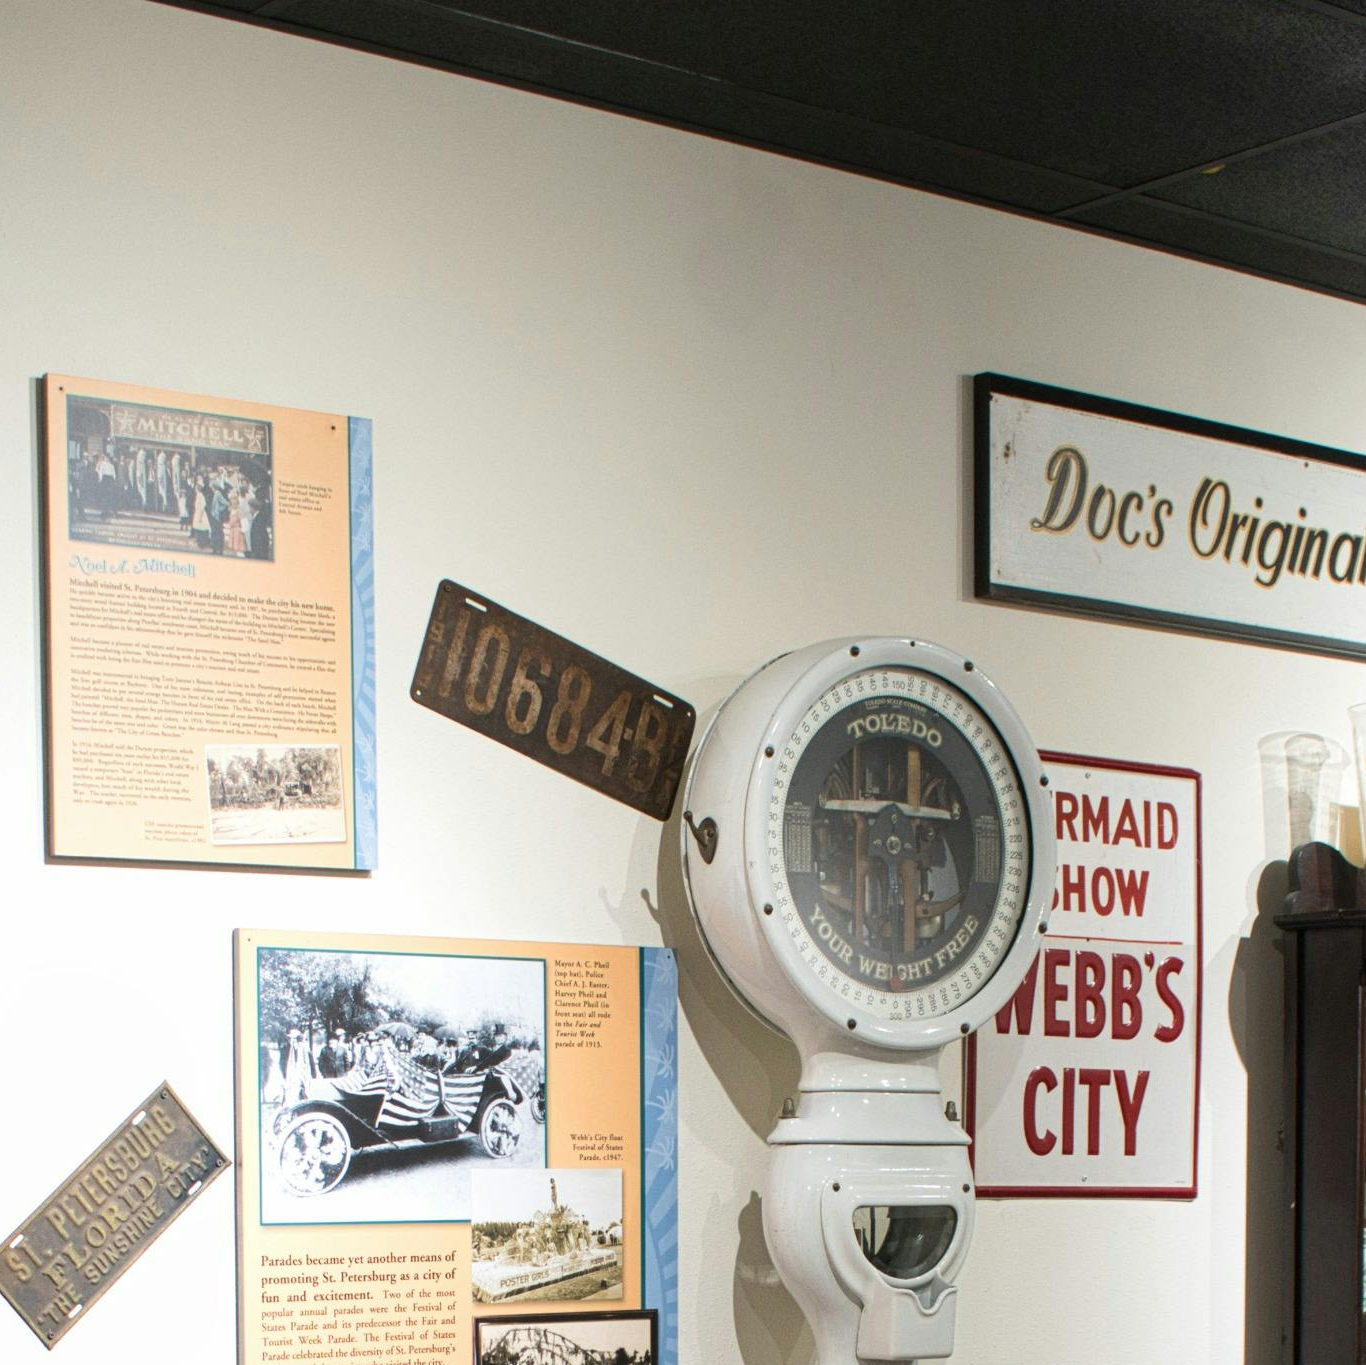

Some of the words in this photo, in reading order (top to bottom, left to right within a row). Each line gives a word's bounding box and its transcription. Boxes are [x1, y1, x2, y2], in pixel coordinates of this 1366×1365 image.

[137, 417, 244, 443] MITCHELL
[1031, 442, 1174, 550] Doc's
[846, 713, 943, 748] TOLEDO
[1049, 862, 1151, 918] HOW
[807, 902, 854, 968] YOUR
[937, 915, 981, 968] FREE
[1023, 1065, 1151, 1157] CITY
[5, 1237, 56, 1283] ST.
[47, 1105, 178, 1241] PETERSBURG
[42, 1149, 180, 1291] FLORIDA
[83, 1202, 165, 1286] SUNSHINE
[261, 1254, 303, 1267] Parades
[306, 1253, 345, 1266] became
[347, 1254, 364, 1268] yet
[367, 1252, 407, 1265] another
[410, 1253, 442, 1264] means
[444, 1250, 457, 1262] of
